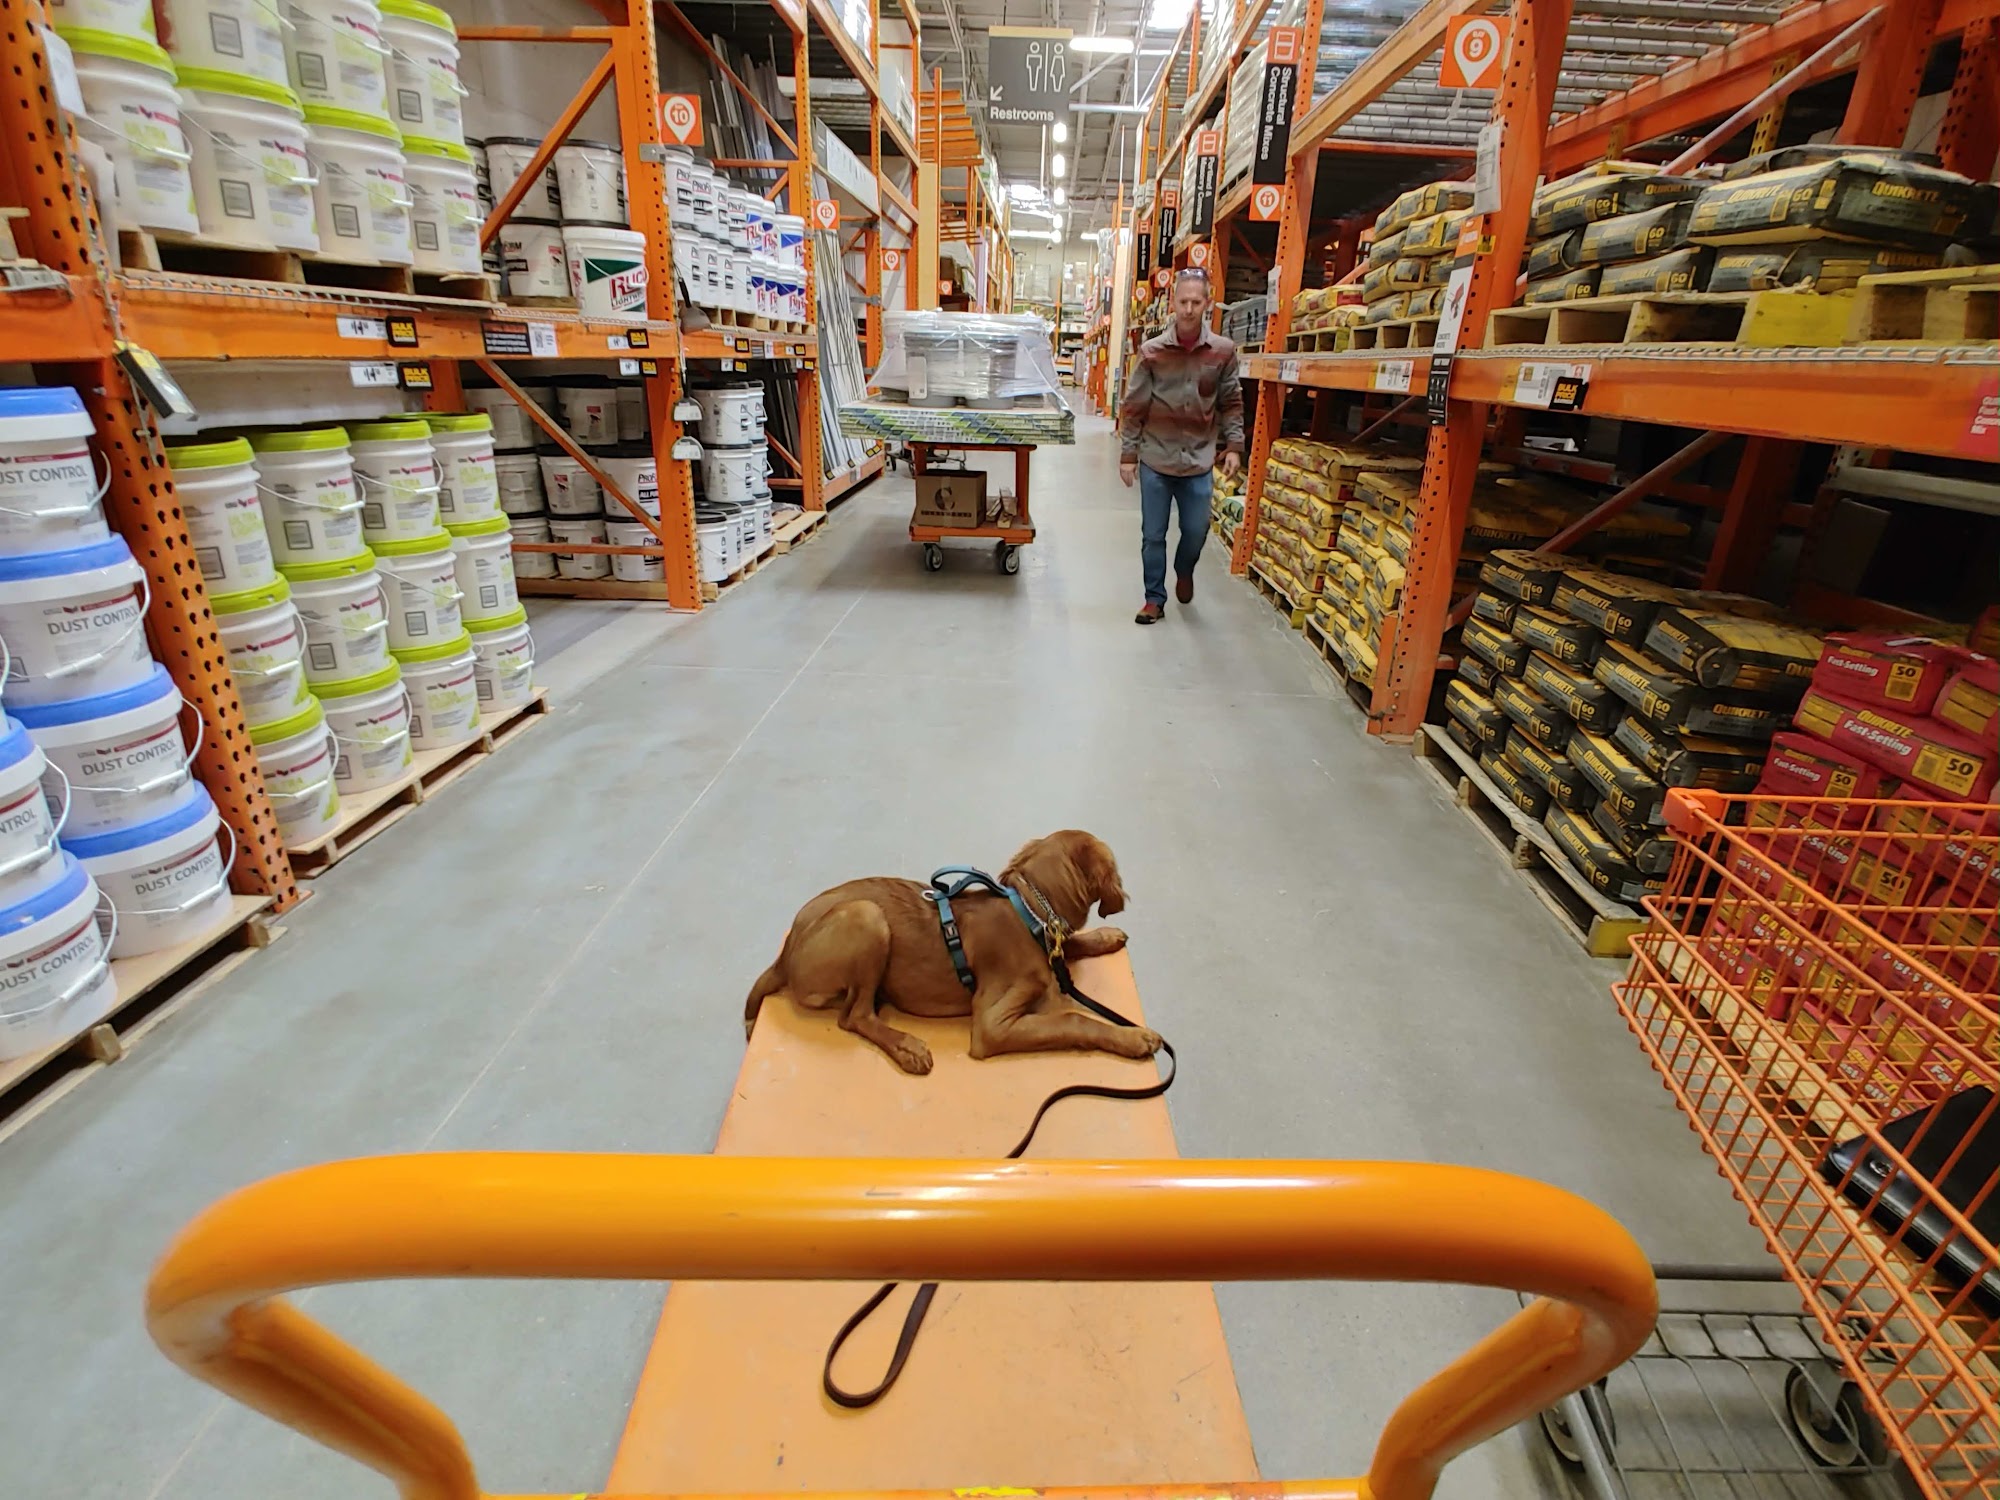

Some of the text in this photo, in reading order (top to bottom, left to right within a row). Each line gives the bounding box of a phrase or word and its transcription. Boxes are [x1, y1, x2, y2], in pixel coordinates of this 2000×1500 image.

[1469, 38, 1483, 58] 9
[1276, 66, 1292, 125] Structural
[672, 110, 689, 124] 10
[990, 106, 1055, 121] Restrooms
[1260, 66, 1281, 160] Concrete Mixes
[1727, 183, 1785, 203] QUIKRETE
[1793, 188, 1813, 201] 60
[1871, 180, 1939, 202] QUIKRETE
[1597, 198, 1610, 209] 60
[1649, 227, 1665, 240] 60
[1671, 273, 1687, 284] 60
[1577, 284, 1591, 294] 60
[1559, 383, 1578, 393] BULK
[1471, 525, 1524, 542] QUIKRETE
[1531, 585, 1543, 594] 60
[1575, 588, 1612, 610] QUIKRETE
[47, 618, 91, 635] DUST
[1528, 618, 1560, 637] QUIKRETE
[1617, 616, 1632, 627] 60
[1657, 621, 1691, 644] QUIKRETE
[1563, 642, 1576, 653] 60
[1505, 657, 1516, 667] 60
[1827, 656, 1879, 677] Fast-Setting
[1615, 663, 1650, 691] QUIKRETE
[1896, 666, 1917, 678] 50
[1542, 671, 1577, 696] QUIKRETE
[1507, 692, 1535, 716] QUIKRETE
[1581, 703, 1595, 715] 60
[1656, 700, 1671, 713] 60
[1713, 703, 1771, 719] QUIKRETE
[1485, 727, 1496, 737] 60
[1539, 723, 1551, 734] 60
[1625, 716, 1655, 743] QUIKRETE
[1856, 710, 1914, 739] QUIKRETE
[1843, 720, 1912, 756] Fast-Setting
[81, 738, 177, 776] DUST CONTROL
[1522, 746, 1554, 775] QUIKRETE
[1492, 760, 1518, 787] QUIKRETE
[1583, 749, 1616, 784] QUIKRETE
[1773, 757, 1821, 782] Fast-Setting
[1946, 758, 1974, 777] 50
[1834, 774, 1851, 785] 50
[1559, 783, 1572, 795] 60
[1522, 795, 1534, 807] 60
[1621, 796, 1636, 809] 60
[1560, 823, 1590, 858] QUIKRETE
[135, 875, 172, 896] DUST
[1595, 871, 1610, 884] 60
